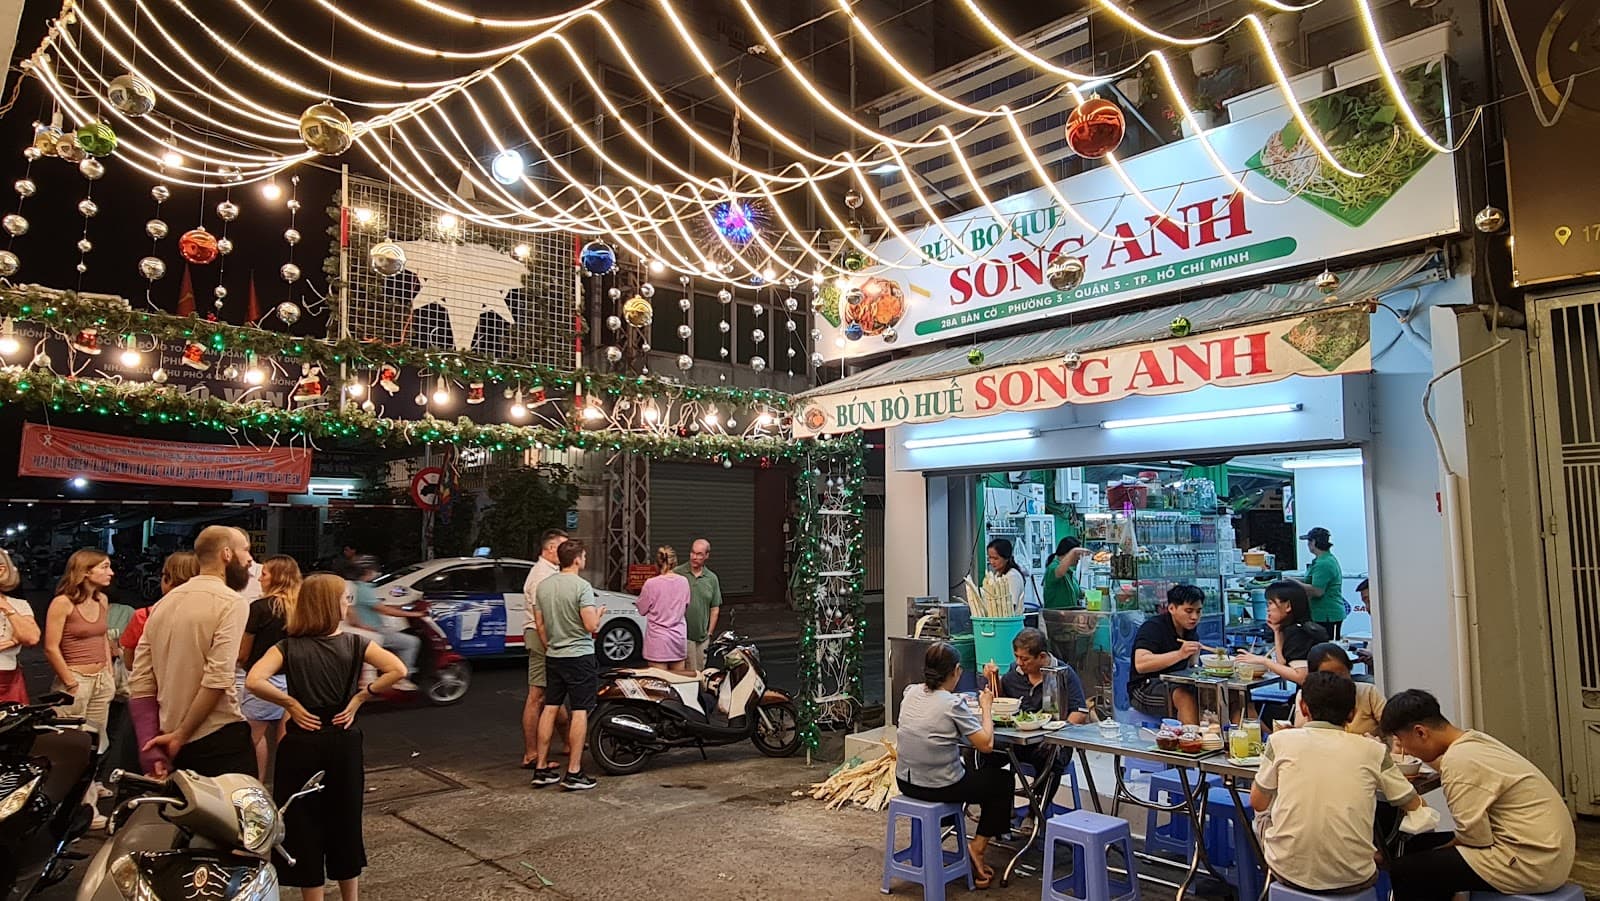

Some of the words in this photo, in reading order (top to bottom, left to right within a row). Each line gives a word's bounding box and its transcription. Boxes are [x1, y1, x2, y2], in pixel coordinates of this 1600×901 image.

[1101, 193, 1252, 270] ANH
[1008, 296, 1053, 314] PHƯỜNG
[1074, 281, 1111, 299] QUẬN
[1113, 280, 1122, 291] 3
[1181, 260, 1205, 276] CHÍ
[1209, 251, 1250, 270] MINH
[835, 394, 877, 428] BÚN
[880, 389, 910, 423] BÒ
[914, 375, 964, 418] HUẾ
[973, 357, 1113, 411] SONG
[1124, 331, 1273, 391] ANH
